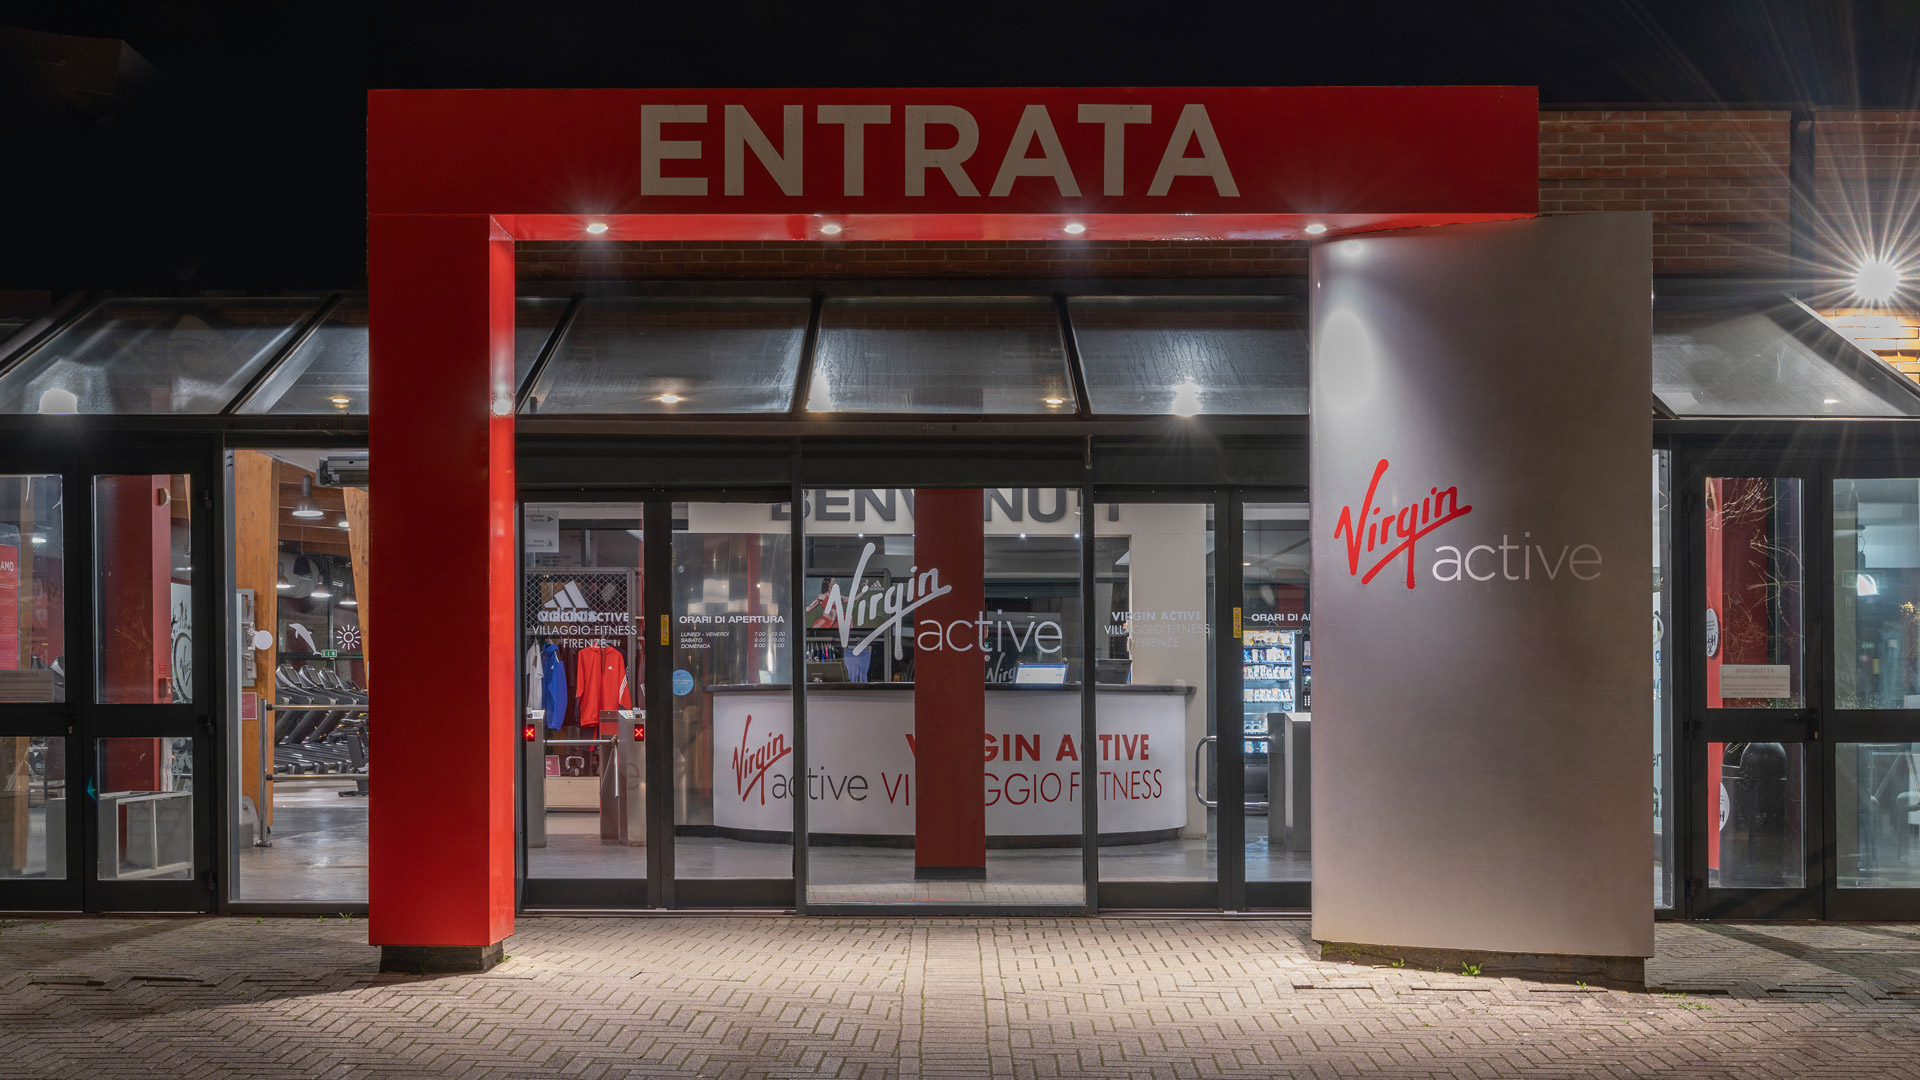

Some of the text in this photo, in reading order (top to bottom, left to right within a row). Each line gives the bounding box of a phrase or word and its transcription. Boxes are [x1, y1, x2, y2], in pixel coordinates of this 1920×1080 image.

[641, 103, 1241, 198] ENTRATA
[1334, 459, 1472, 589] Virgin
[1432, 532, 1602, 581] active
[824, 542, 952, 660] Virgin
[588, 612, 629, 622] ACTIVE
[679, 615, 785, 623] ORARI DI APERTURA
[1112, 610, 1202, 622] VIRGIN ACTIVE
[1251, 613, 1285, 622] ORARI
[1287, 613, 1298, 621] DI
[532, 625, 637, 635] VILLAGGIO FITNESS
[917, 609, 1063, 653] active
[1104, 623, 1210, 635] VILLAGGIO FITNESS
[563, 638, 606, 649] FIRENZE
[1135, 637, 1179, 648] FIRENZE
[1055, 734, 1149, 761] ATIVE
[732, 714, 792, 805] Virgin
[1069, 769, 1162, 802] FTNESS
